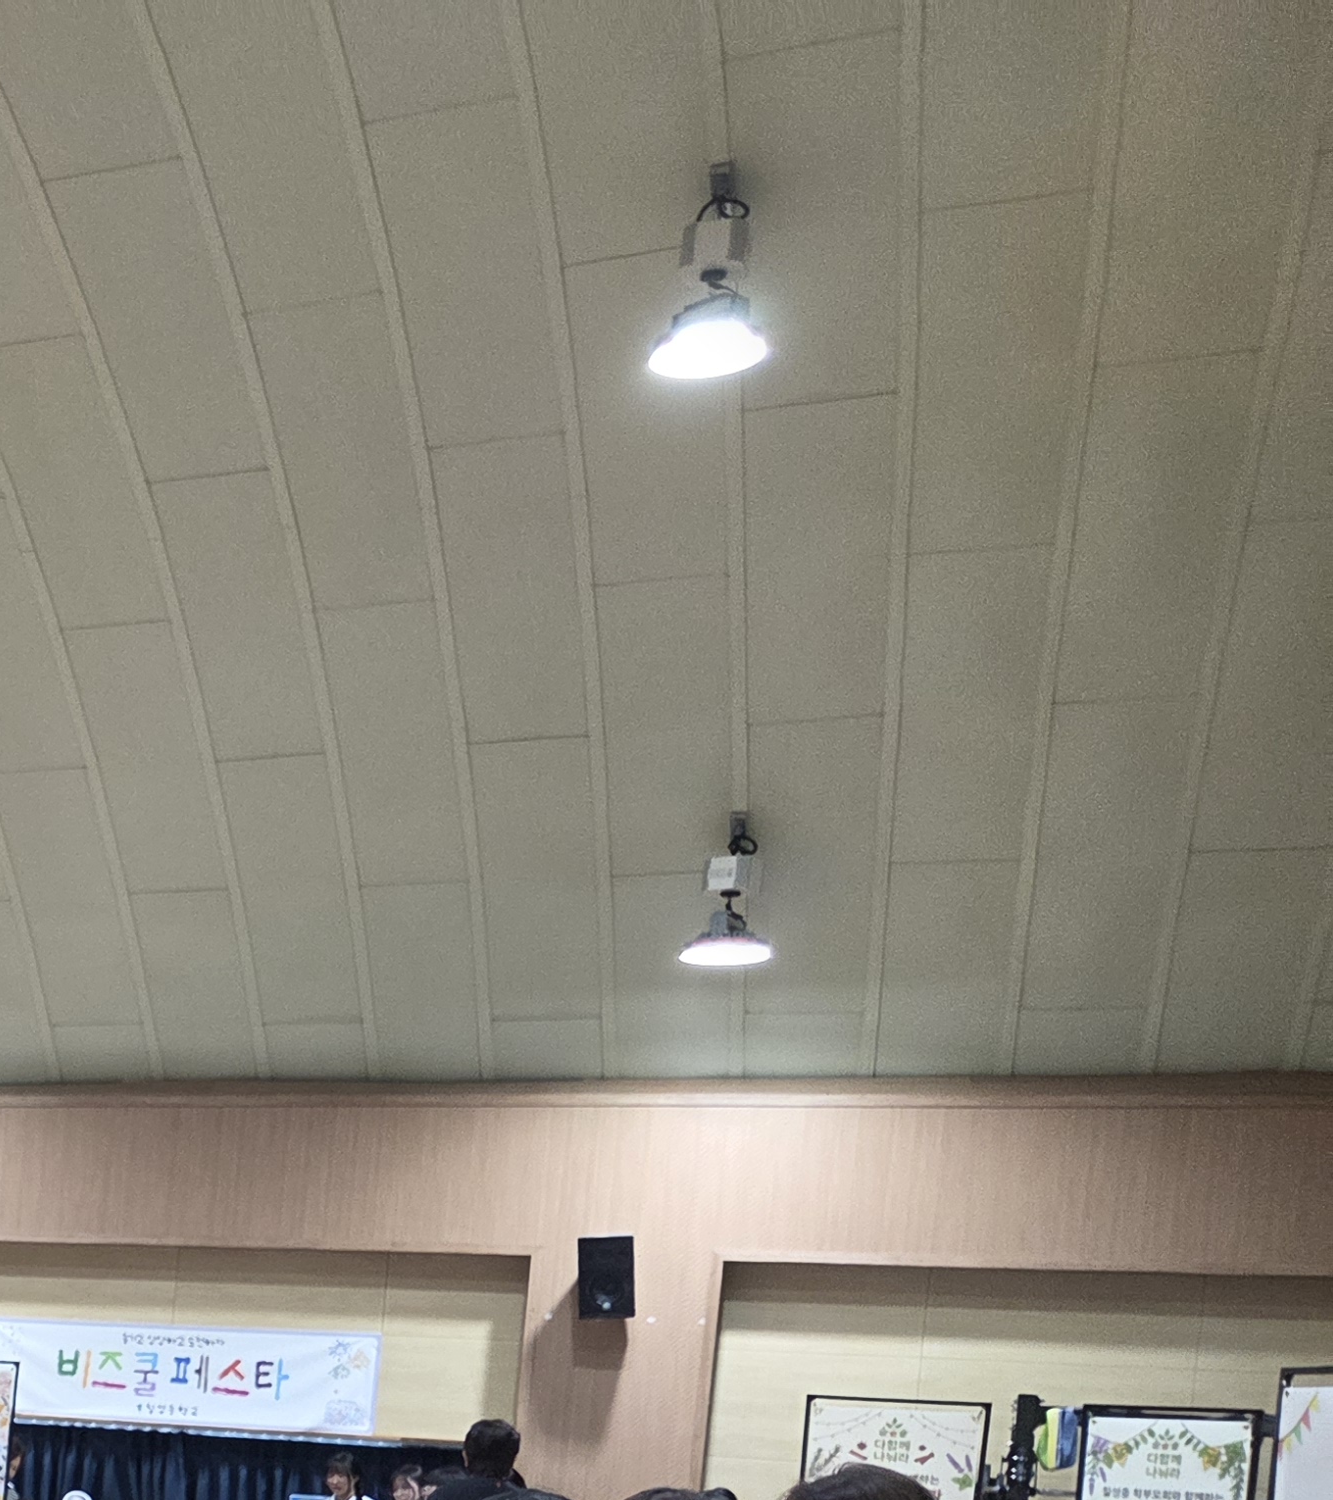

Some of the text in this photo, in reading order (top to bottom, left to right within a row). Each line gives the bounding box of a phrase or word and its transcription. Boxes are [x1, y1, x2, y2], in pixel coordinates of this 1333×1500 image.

[57, 1349, 290, 1400] 비즈쿨 페스타
[874, 1439, 911, 1452] 다함께
[1147, 1453, 1182, 1466] 다함께
[1145, 1467, 1180, 1480] 나눠라
